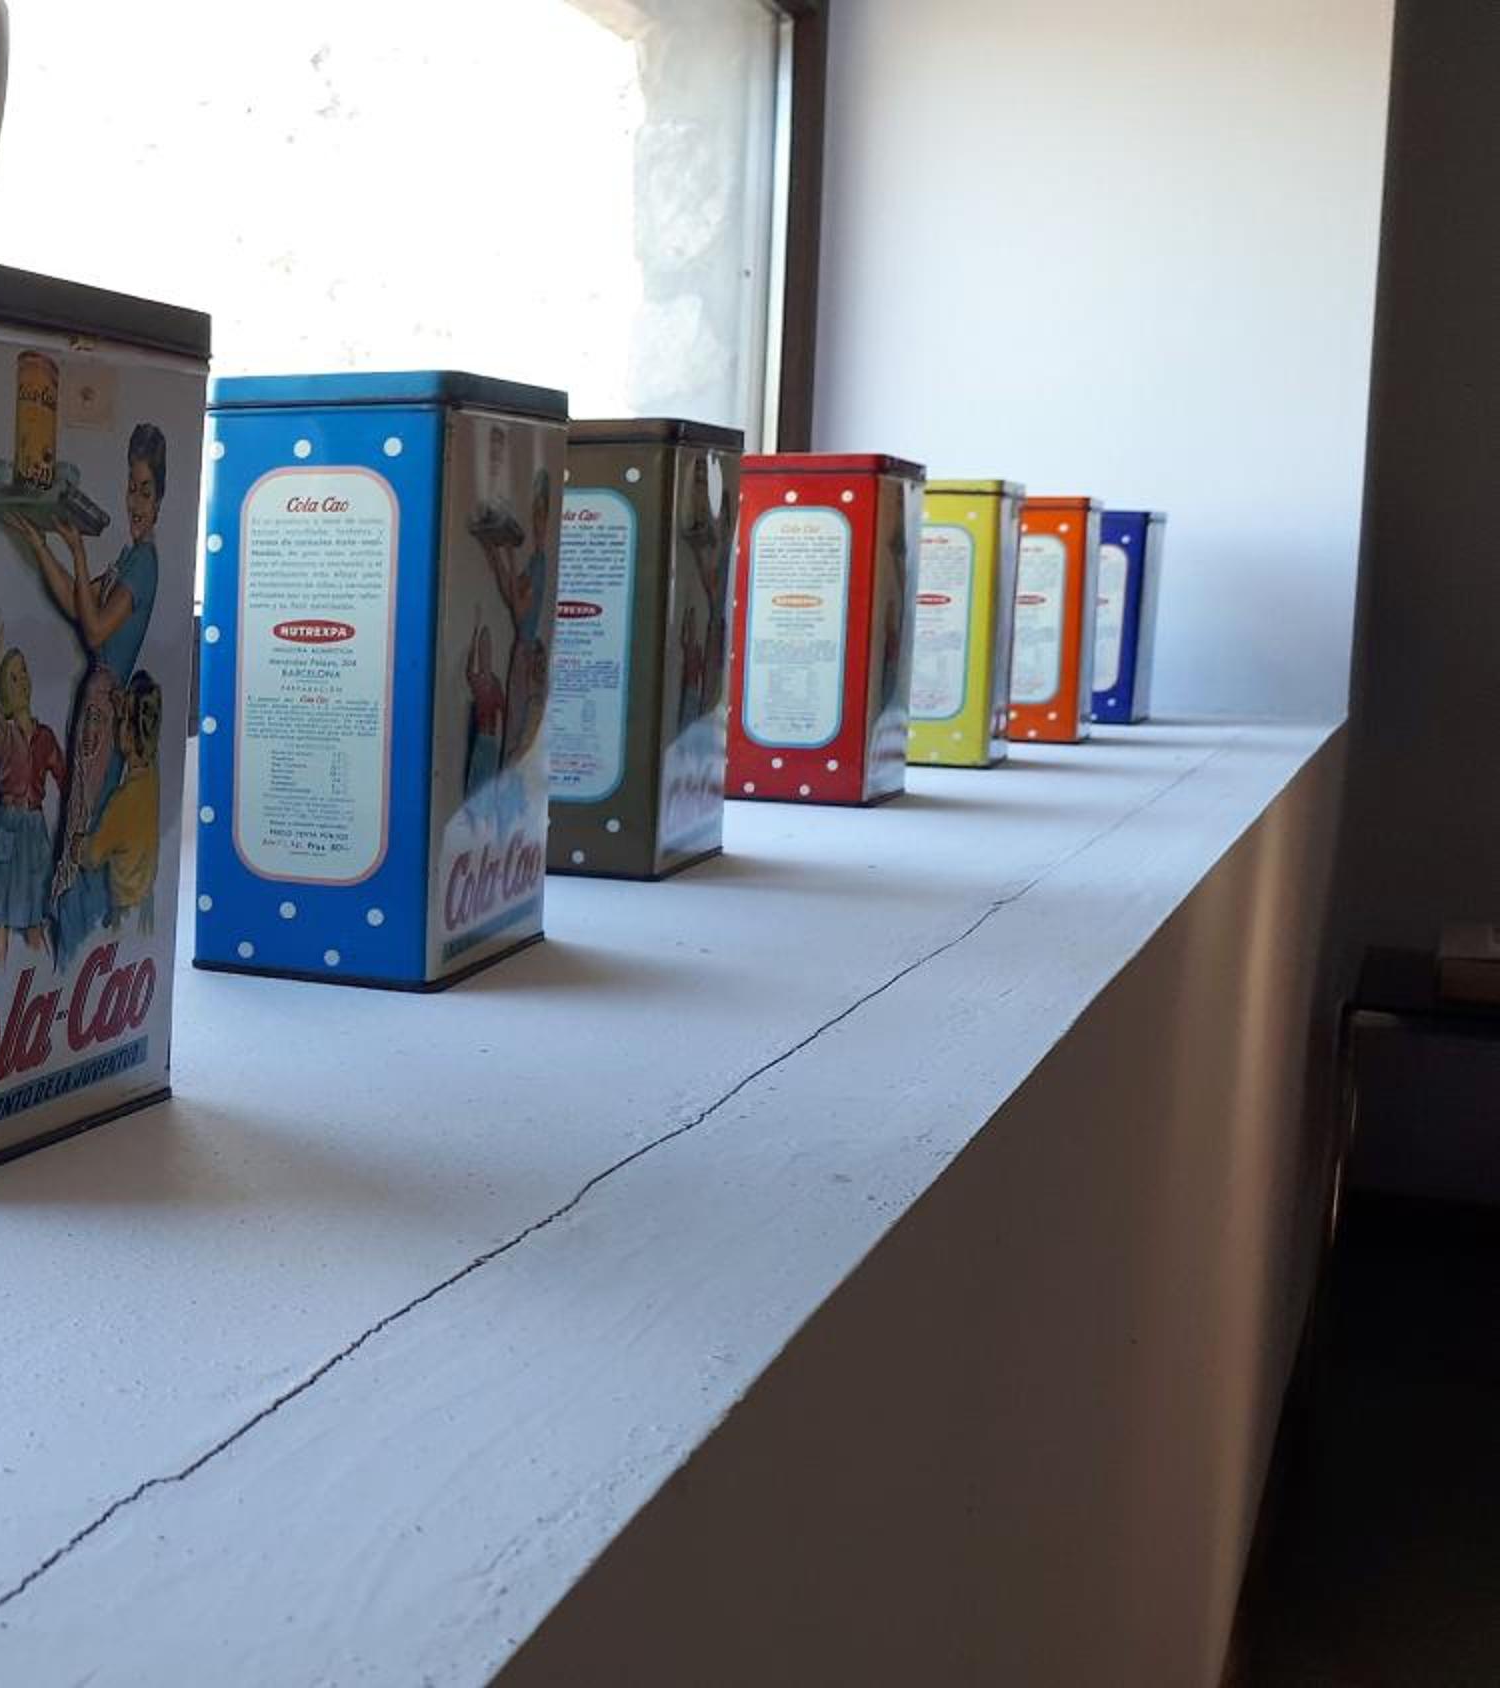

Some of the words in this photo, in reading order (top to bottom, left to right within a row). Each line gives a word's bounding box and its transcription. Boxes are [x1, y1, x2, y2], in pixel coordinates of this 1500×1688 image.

[287, 496, 319, 513] Cola
[321, 496, 349, 513] Cao
[280, 626, 348, 638] NUTREXPA
[282, 669, 341, 679] BARCELONA
